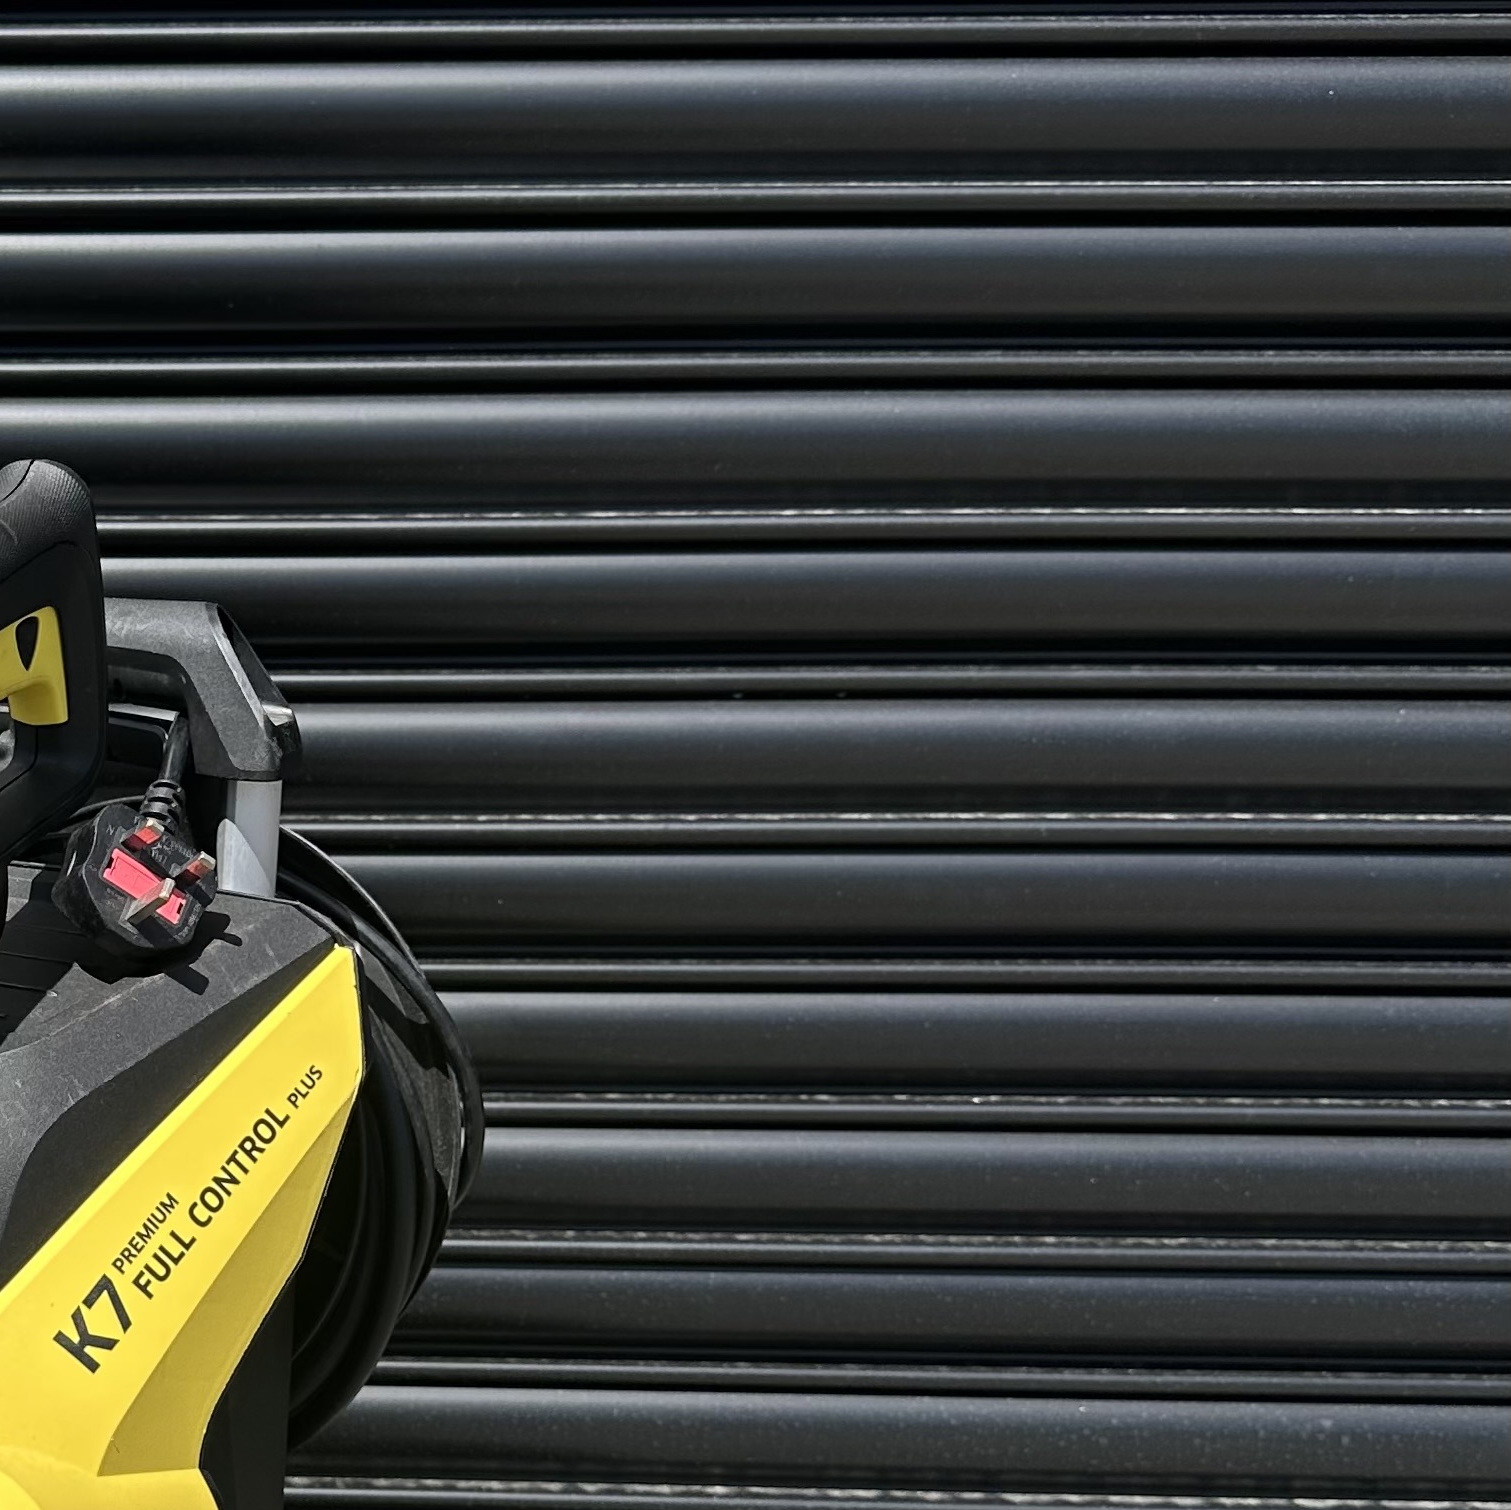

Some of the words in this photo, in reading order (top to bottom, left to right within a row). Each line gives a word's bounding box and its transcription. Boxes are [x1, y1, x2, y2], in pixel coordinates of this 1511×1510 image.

[131, 1230, 197, 1300] FULL
[188, 1107, 290, 1228] CONTROL
[287, 1065, 323, 1110] PLUS
[111, 1192, 180, 1275] PREMIUM
[52, 1273, 132, 1374] K7
